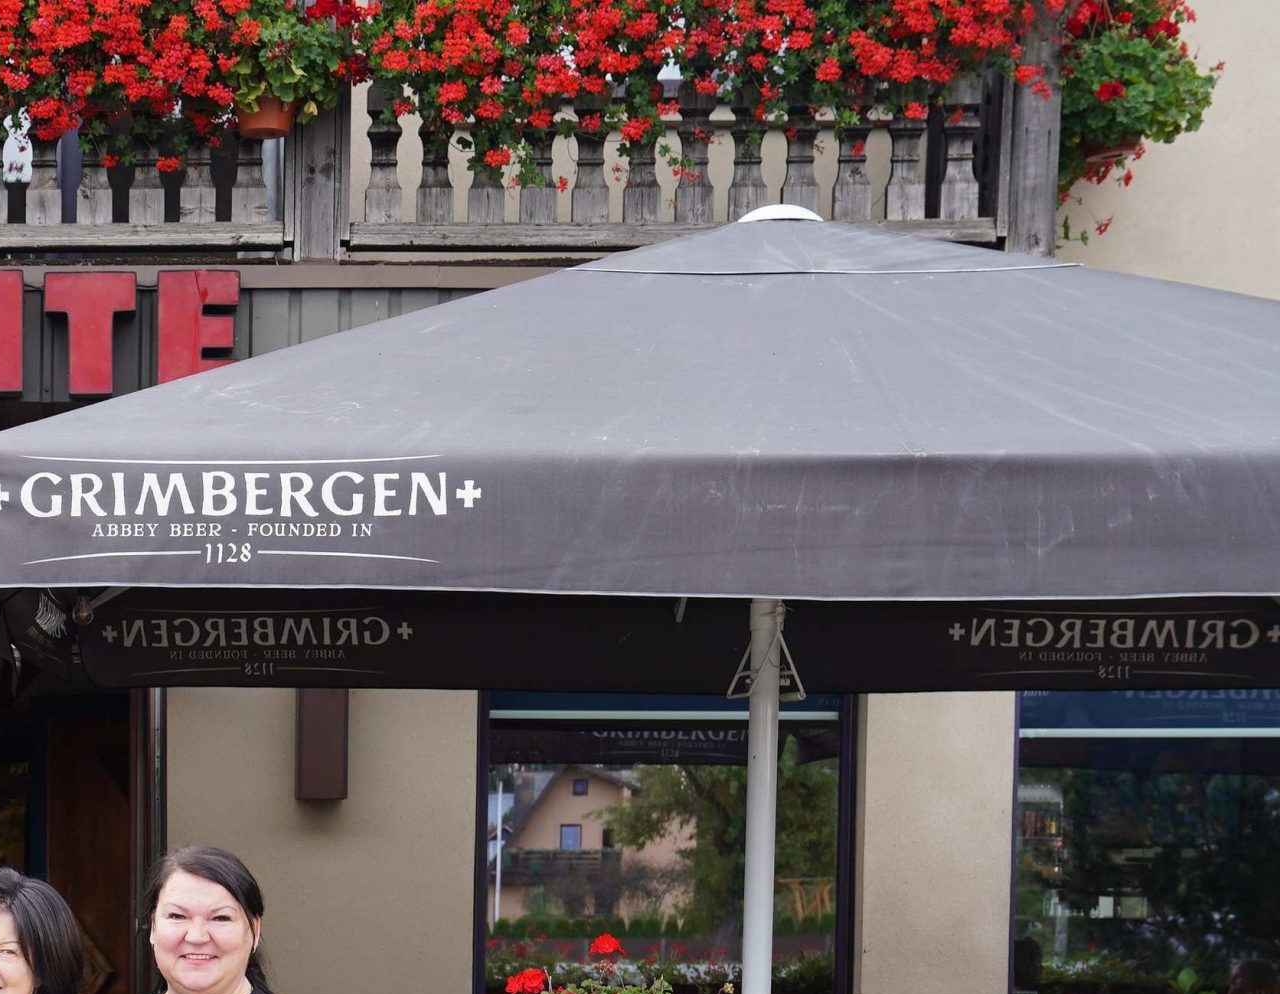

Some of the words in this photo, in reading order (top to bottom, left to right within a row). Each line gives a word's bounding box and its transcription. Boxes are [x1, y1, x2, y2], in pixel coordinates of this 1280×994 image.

[20, 471, 448, 518] GRIMBERGEN
[92, 523, 159, 537] ABBEY
[170, 523, 222, 537] BEER
[247, 523, 341, 537] FOUNDED
[351, 523, 374, 537] IN
[205, 542, 251, 564] 1128
